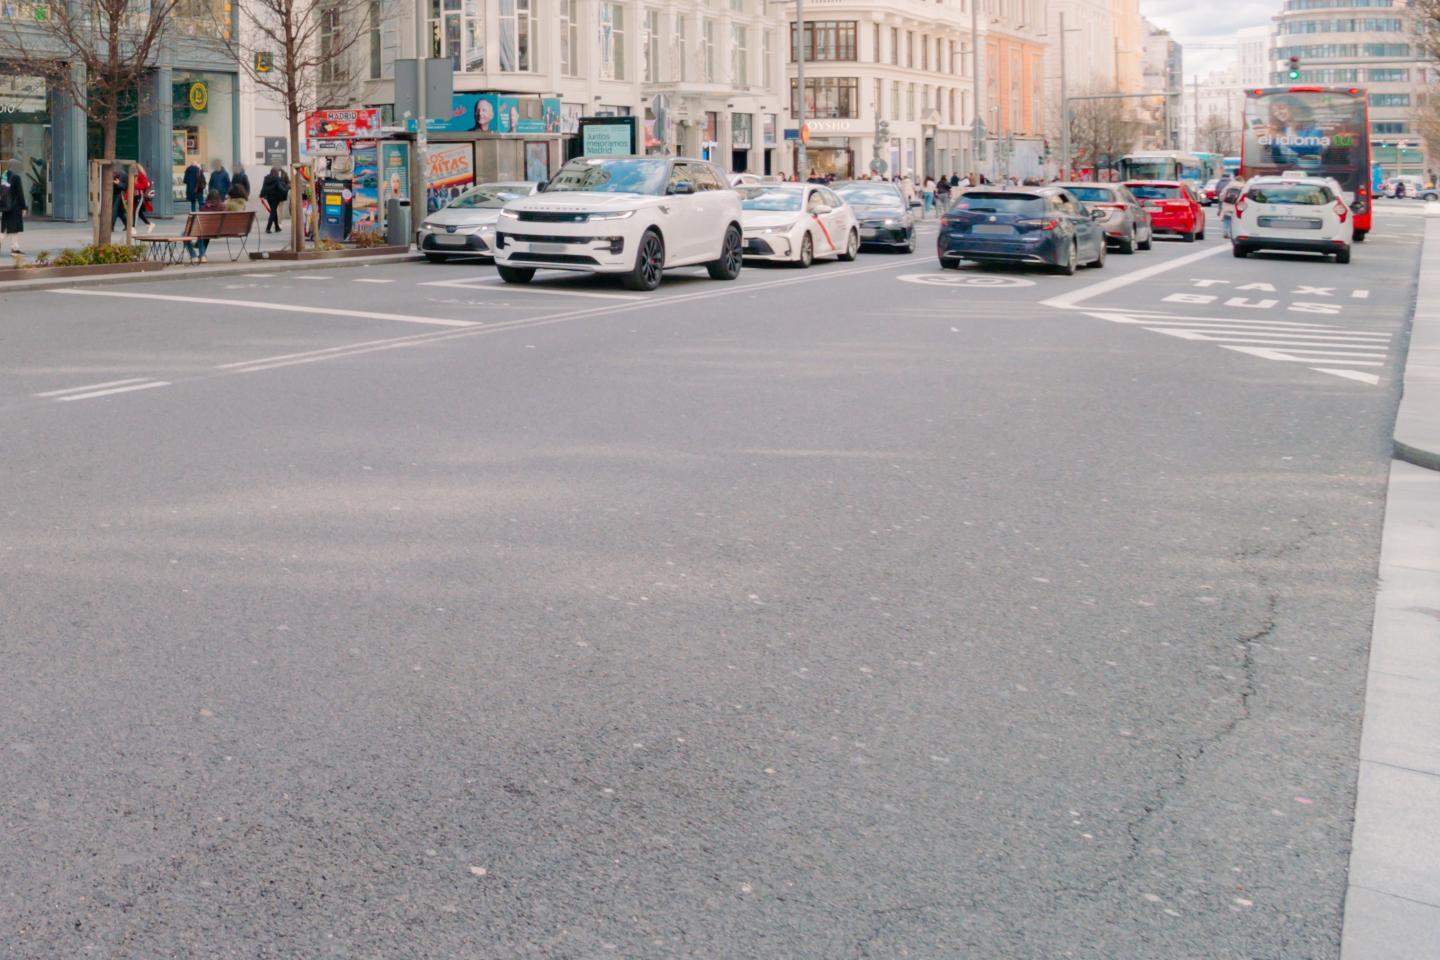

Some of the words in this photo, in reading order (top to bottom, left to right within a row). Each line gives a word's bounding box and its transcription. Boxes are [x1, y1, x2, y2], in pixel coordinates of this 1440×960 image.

[327, 111, 357, 121] MADRID
[807, 121, 851, 130] OYSHO
[1189, 277, 1371, 299] TAXI
[1160, 292, 1344, 315] BUS
